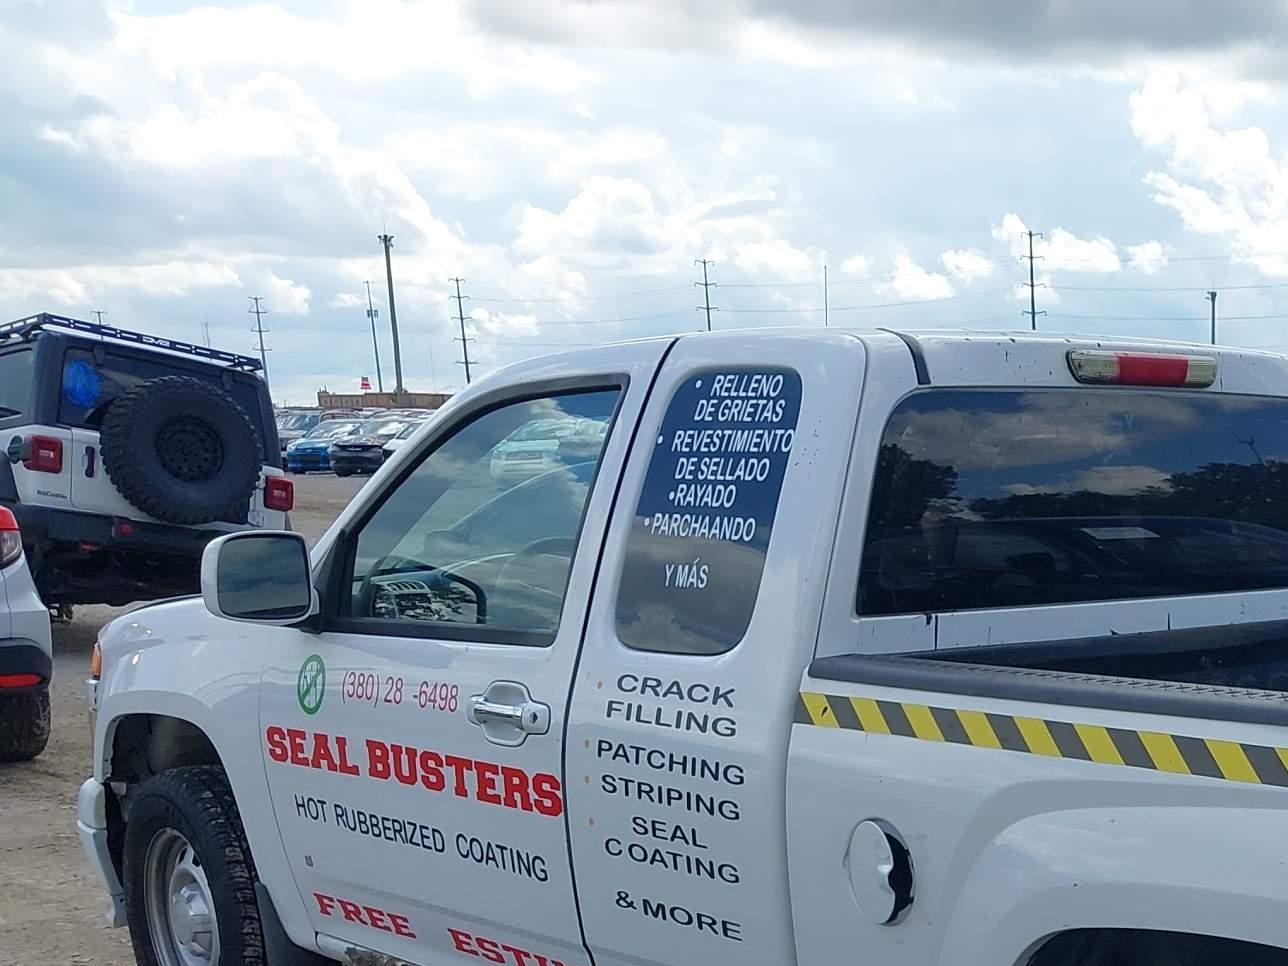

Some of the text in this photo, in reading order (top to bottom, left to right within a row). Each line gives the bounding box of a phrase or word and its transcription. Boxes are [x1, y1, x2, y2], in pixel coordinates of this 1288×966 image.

[710, 375, 783, 397] RELLENO
[694, 400, 785, 422] DE GRIETAS
[672, 429, 795, 453] REVESTIMIENTO
[675, 458, 770, 481] DE SELLADO
[674, 484, 736, 507] RAYADO
[651, 513, 756, 541] PARCHAANDO
[665, 557, 709, 588] Y MÁS
[342, 670, 459, 712] (380) 28 -6498
[616, 674, 735, 708] CRACK
[606, 700, 737, 737] FILLING
[266, 726, 563, 817] SEAL BUSTERS
[597, 739, 745, 785] PATCHING
[601, 774, 741, 821] STRIPING
[294, 794, 548, 882] HOT RUBBERIZED COATING
[631, 816, 708, 849] SEAL
[604, 838, 741, 884] COATING
[313, 891, 416, 939] FREE
[615, 890, 743, 941] & MORE
